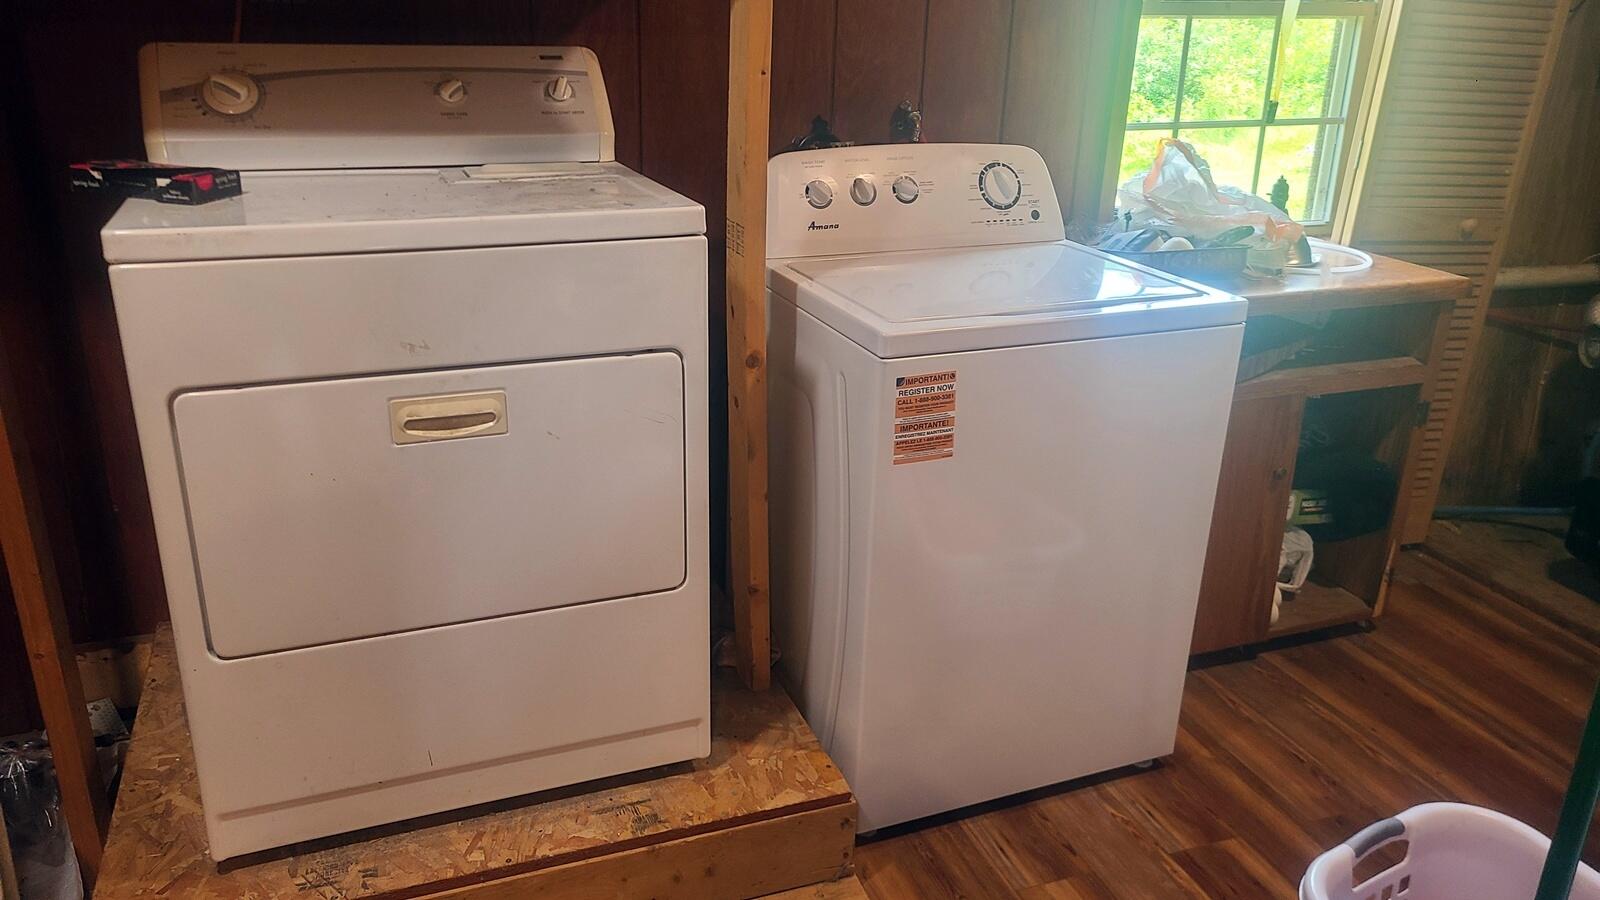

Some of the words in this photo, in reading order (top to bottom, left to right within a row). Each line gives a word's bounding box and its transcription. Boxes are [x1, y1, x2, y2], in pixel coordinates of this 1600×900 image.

[807, 221, 840, 231] Amana
[898, 386, 936, 397] REGISTER
[936, 383, 955, 392] NOW
[897, 398, 914, 406] CALL
[900, 419, 949, 433] IMPORTANTE!
